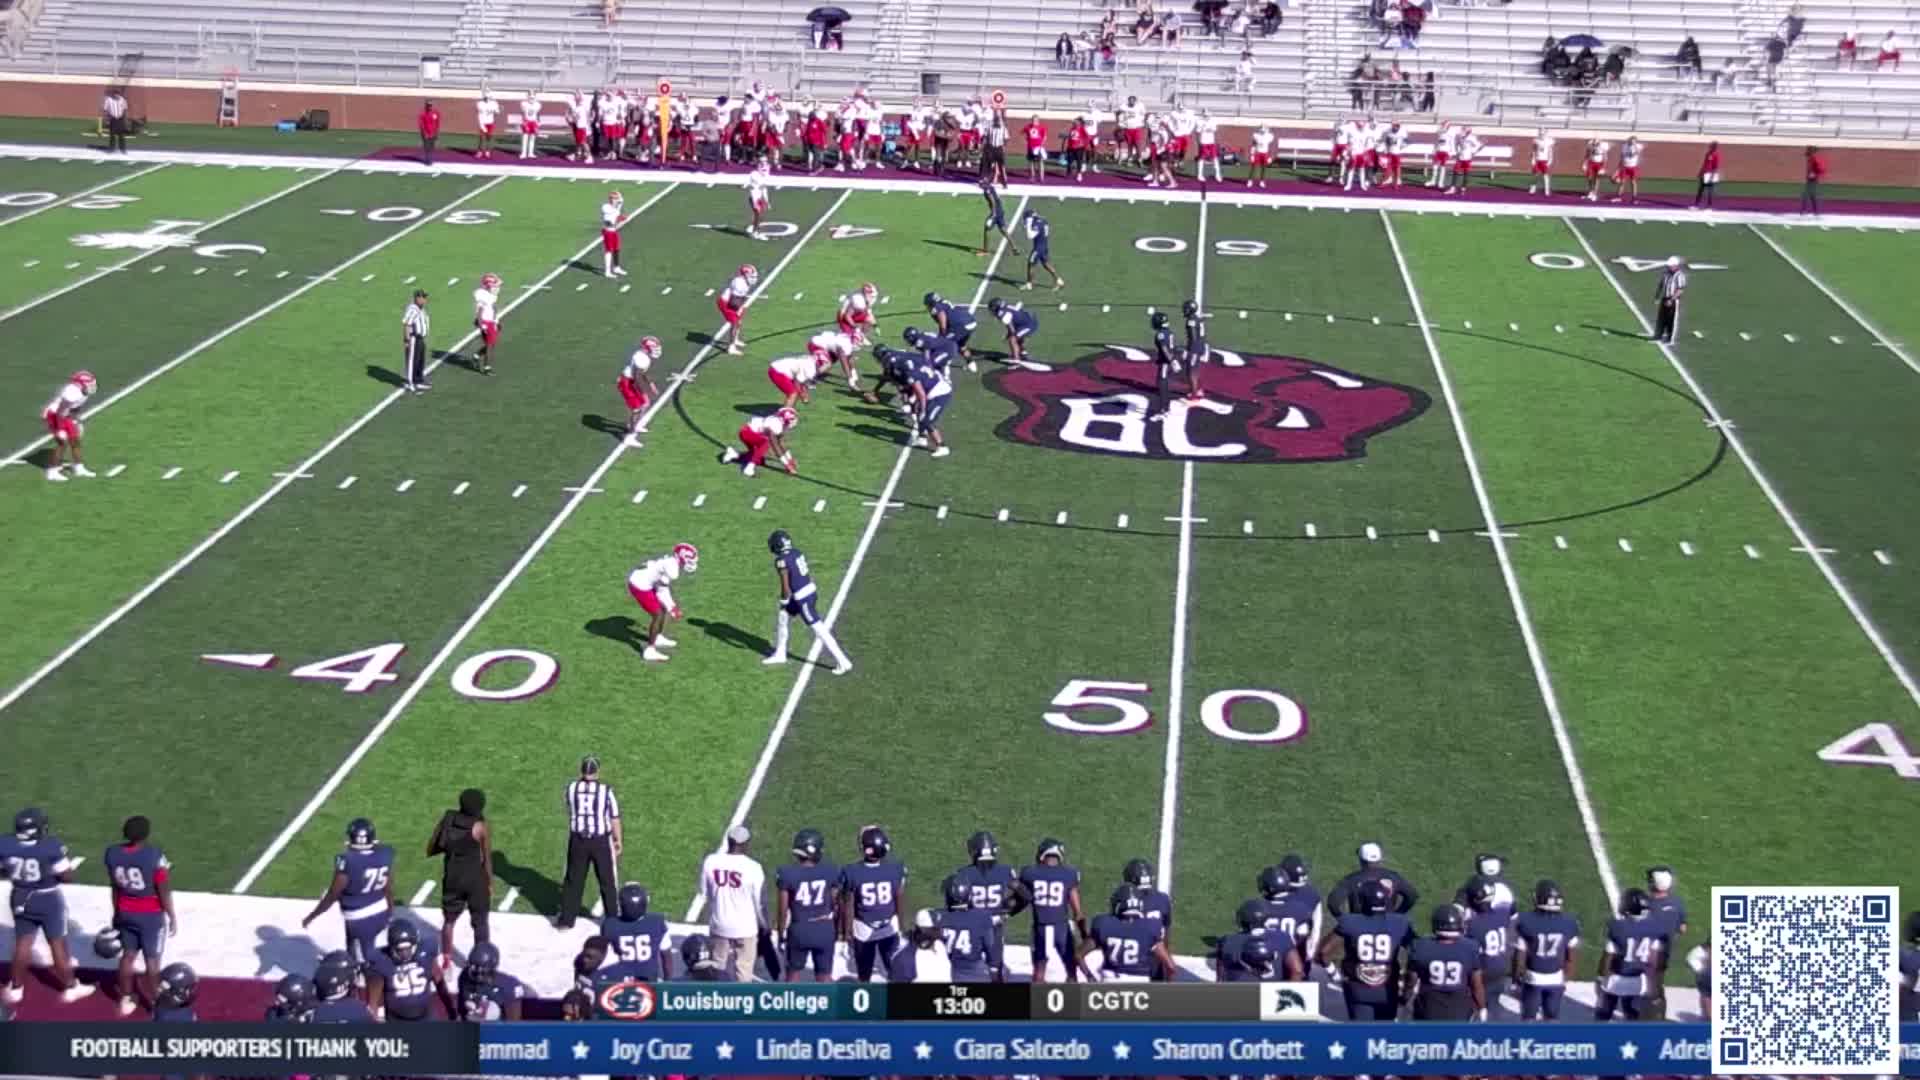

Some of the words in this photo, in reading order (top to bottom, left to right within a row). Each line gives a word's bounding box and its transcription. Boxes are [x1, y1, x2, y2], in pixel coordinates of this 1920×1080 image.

[1059, 393, 1248, 457] BC
[9, 856, 42, 883] 79
[361, 865, 389, 894] 75
[712, 868, 743, 889] US
[795, 879, 827, 907] 47
[860, 881, 893, 907] 58
[971, 884, 1002, 909] 25
[1032, 879, 1065, 907] 29
[618, 935, 652, 961] 56
[942, 928, 972, 955] 74
[1106, 936, 1140, 965] 72
[1356, 933, 1392, 961] 69
[1536, 932, 1564, 957] 17
[1623, 936, 1651, 963] 14
[1427, 960, 1463, 985] 93
